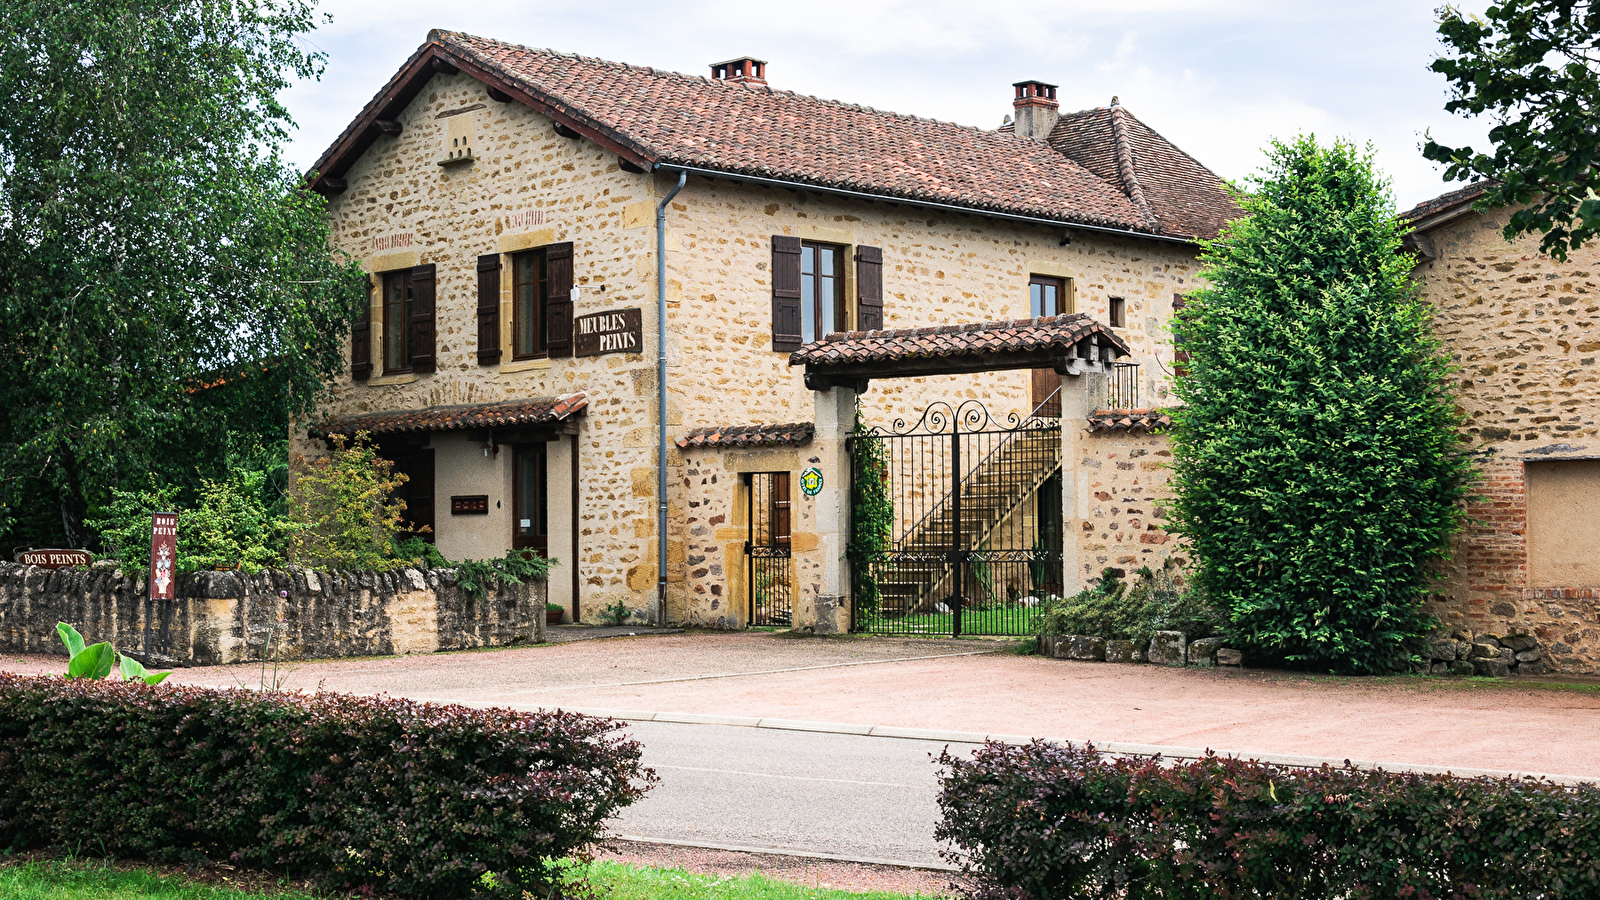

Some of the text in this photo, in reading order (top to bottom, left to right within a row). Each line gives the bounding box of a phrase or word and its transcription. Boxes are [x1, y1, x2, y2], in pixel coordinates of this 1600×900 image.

[579, 313, 626, 335] MEUBLES
[599, 331, 636, 351] PEINTS
[156, 517, 175, 526] BOIS
[153, 527, 177, 536] PEINT
[24, 553, 86, 565] BOIS PEINTS
